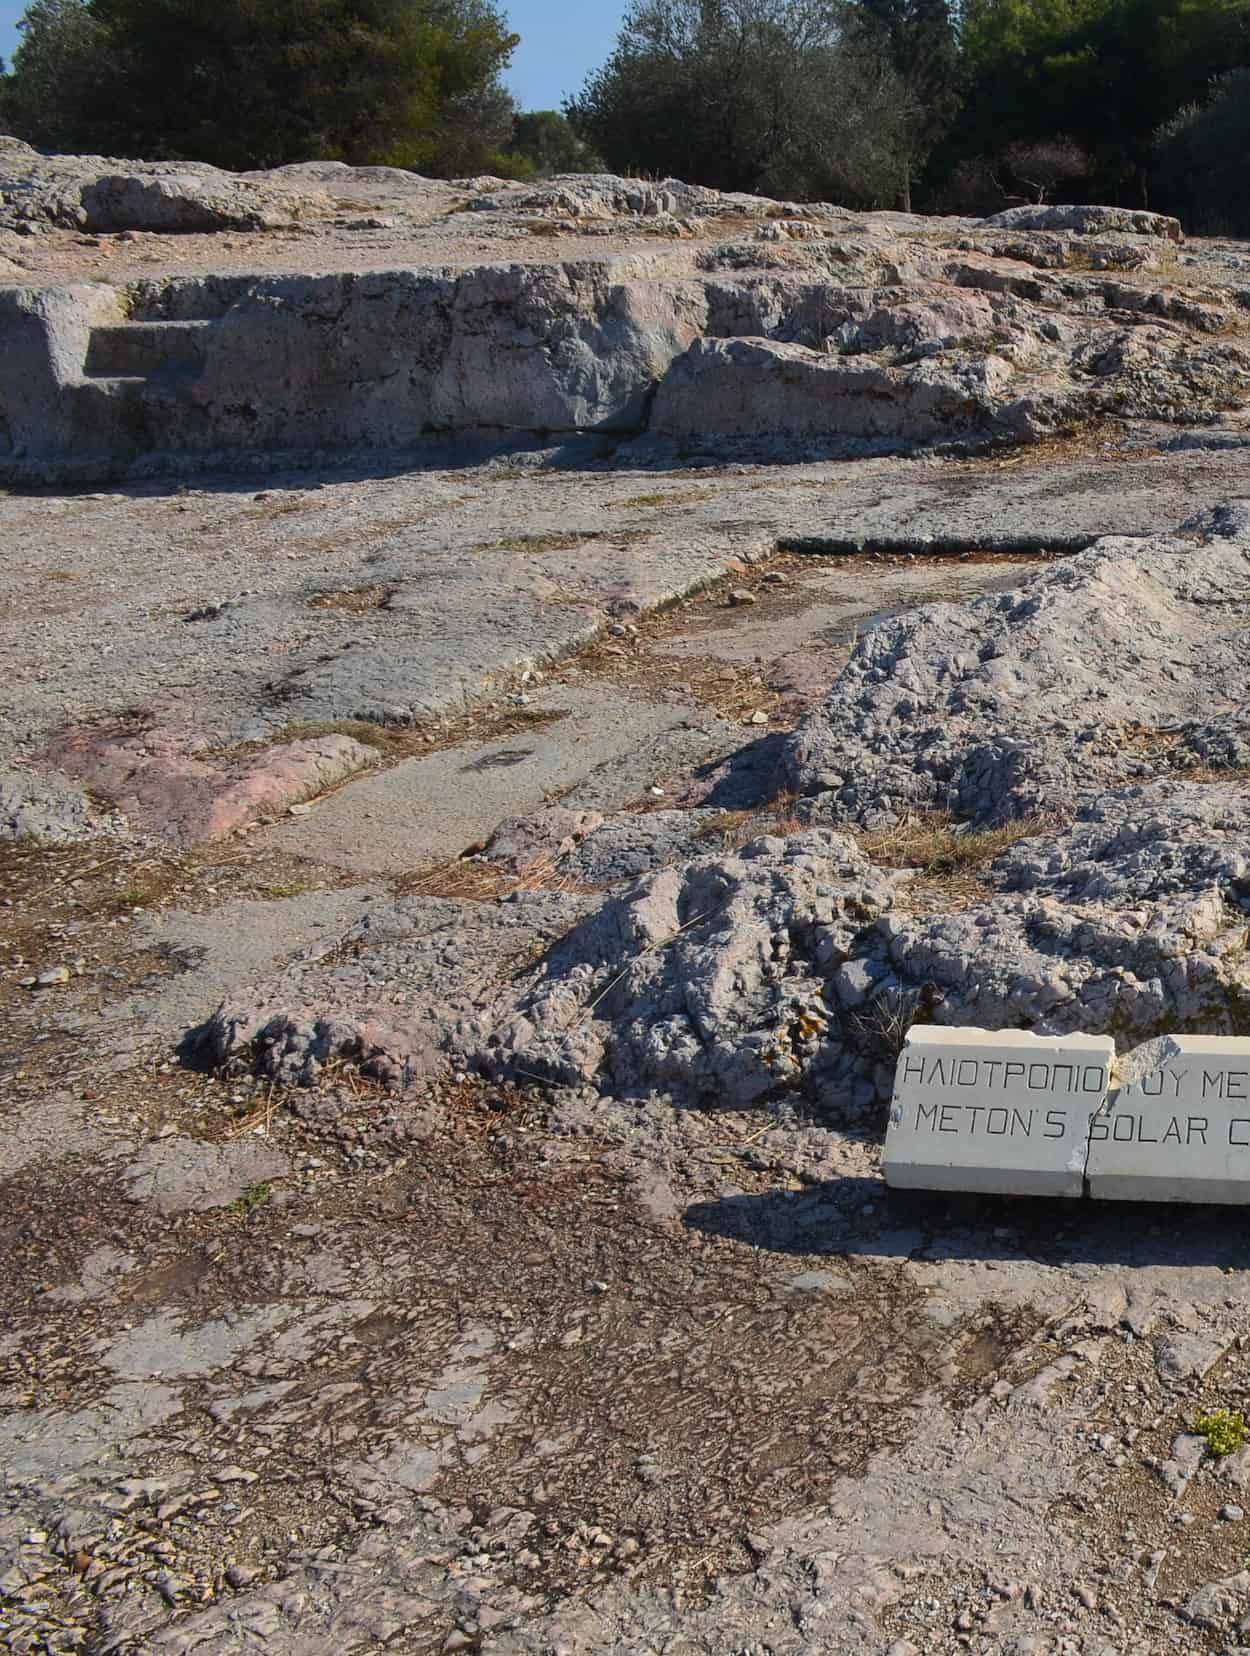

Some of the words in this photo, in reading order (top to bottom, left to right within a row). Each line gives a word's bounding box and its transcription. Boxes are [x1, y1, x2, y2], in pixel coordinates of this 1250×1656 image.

[1122, 1070, 1189, 1097] ΟΥ
[914, 1103, 1065, 1138] METON'S
[1085, 1112, 1208, 1145] SOLAR
